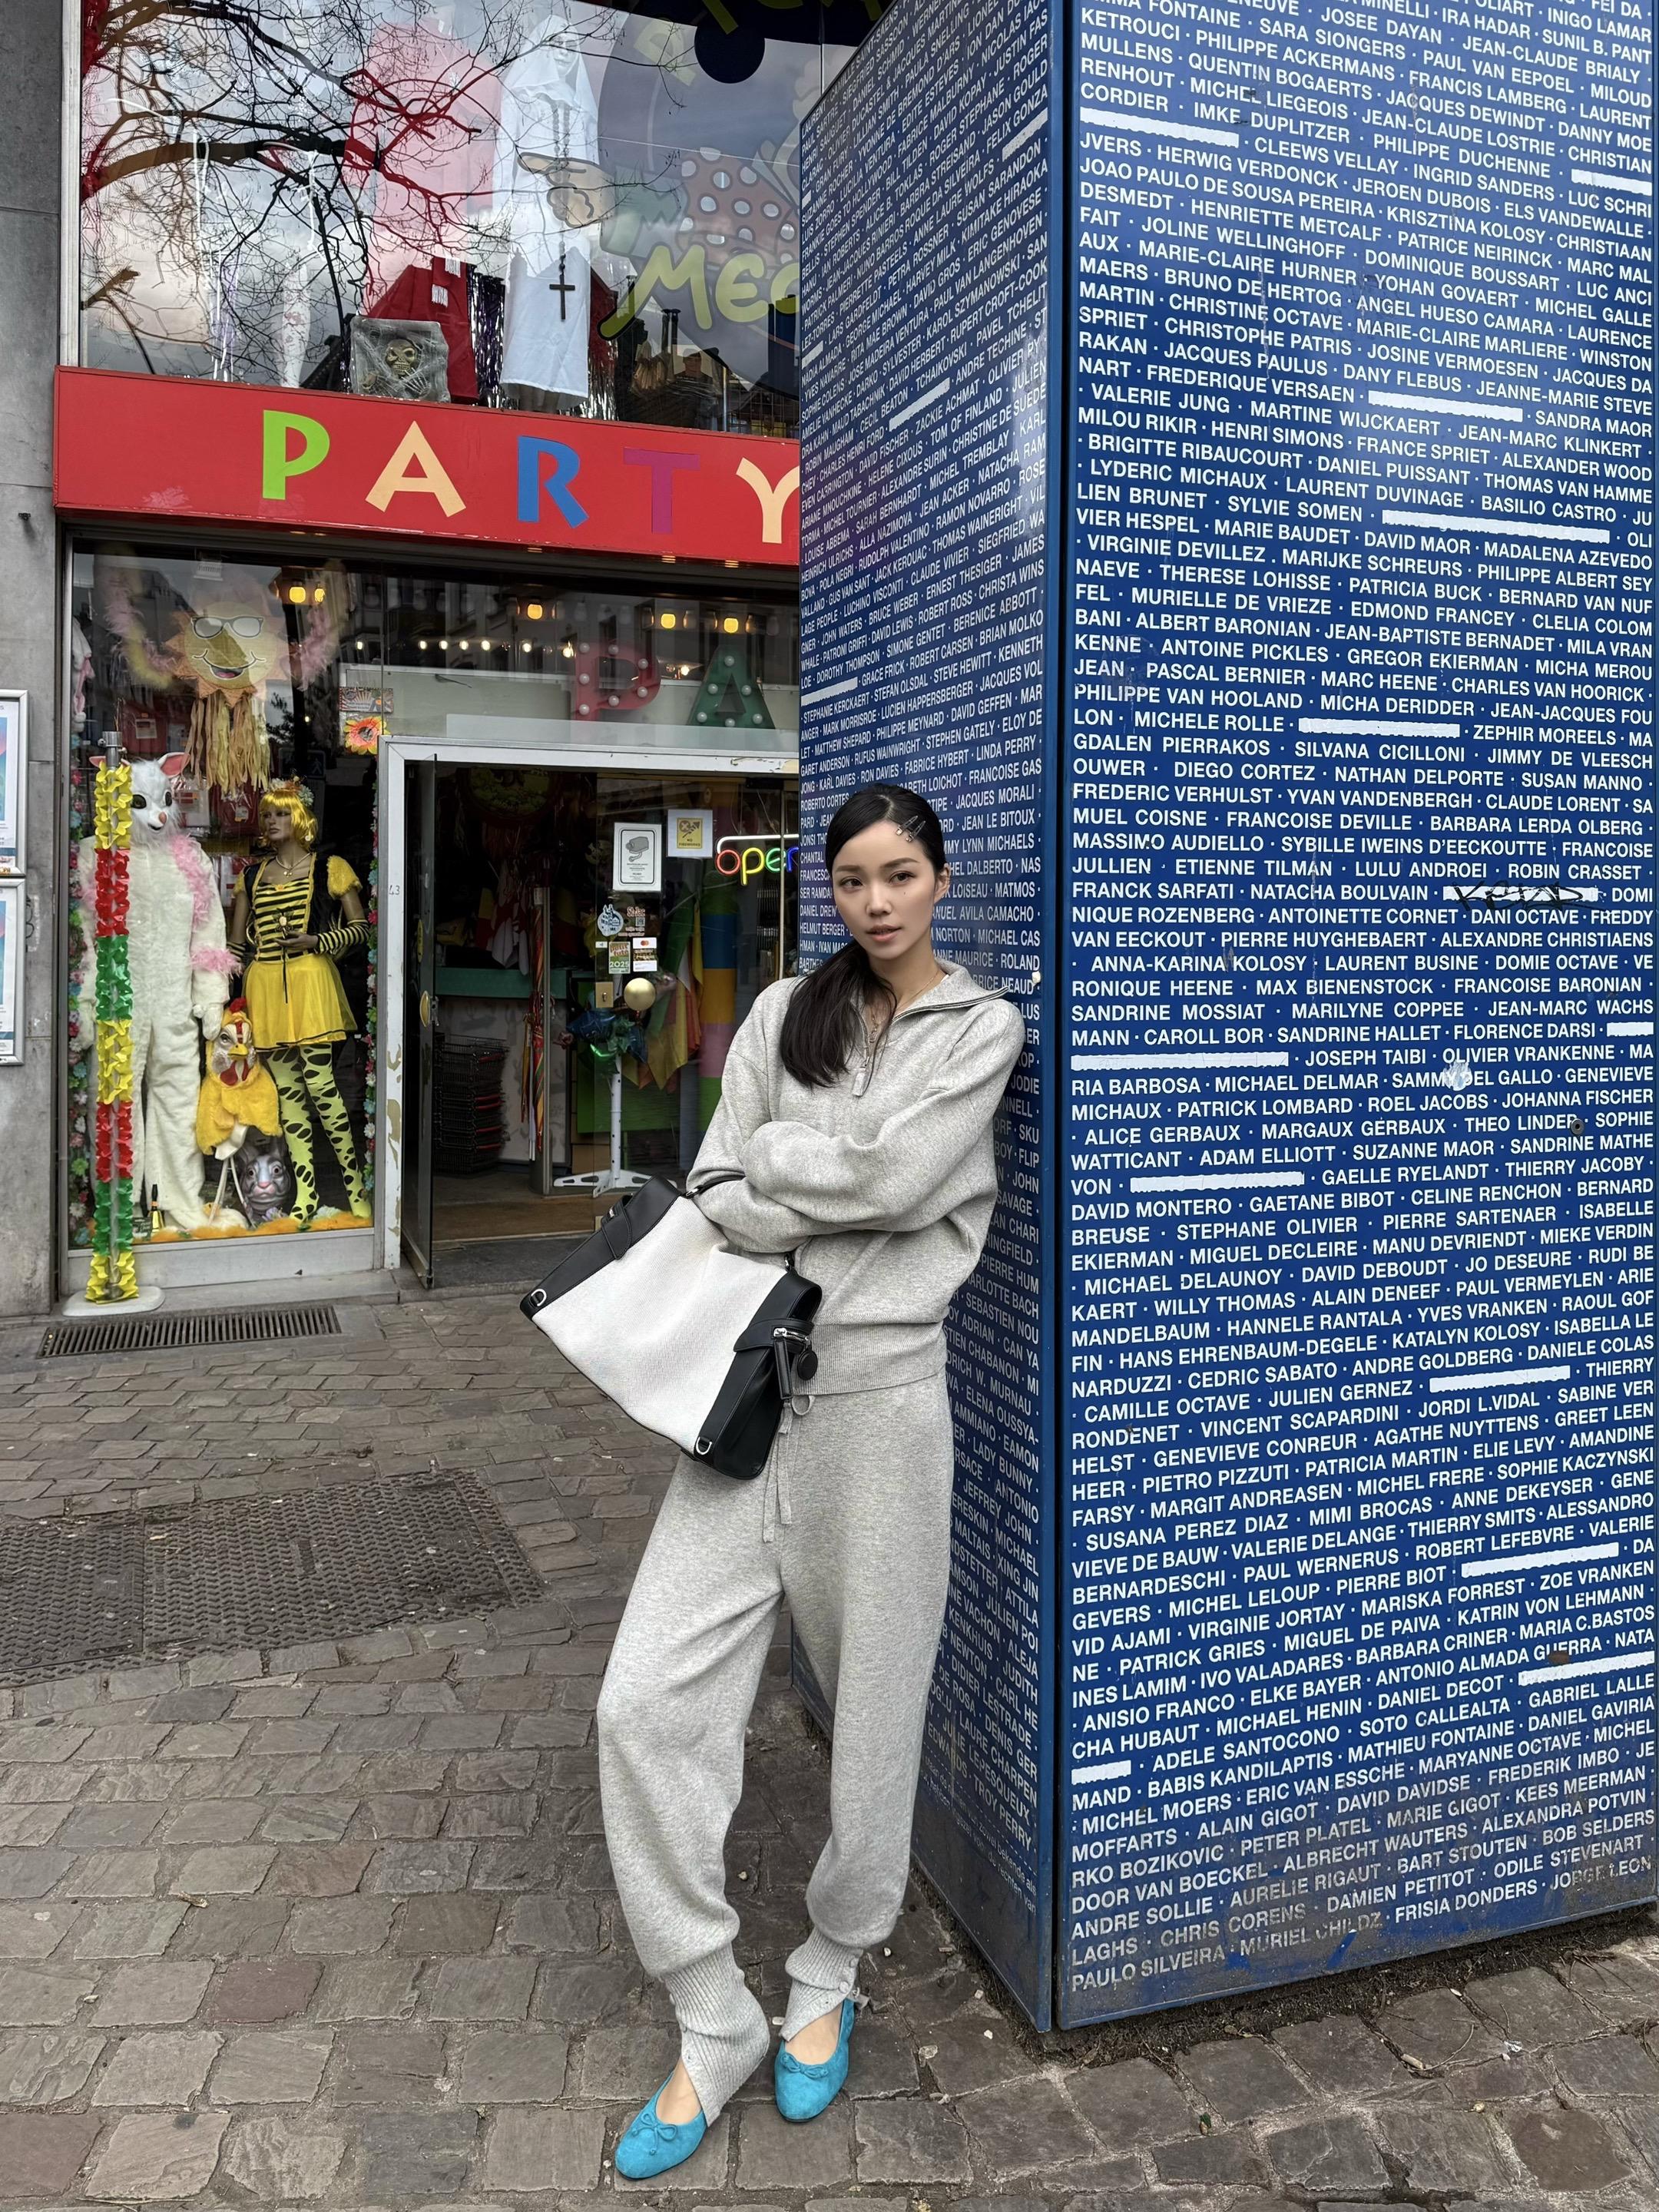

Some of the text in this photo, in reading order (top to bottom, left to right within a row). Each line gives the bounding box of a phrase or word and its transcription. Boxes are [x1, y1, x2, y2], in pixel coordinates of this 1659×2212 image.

[1081, 7, 1651, 130] KETROUCI PHILIPPE ACKERMANS FRANCIS LAMBERG LAURENT
[802, 56, 1047, 316] WORMS JEAN-JACQUES RINIERI BARBRA STREISAND JASON GOULD
[1080, 132, 1643, 238] JVERS HERWIG VERDONCK JEROEN DUBOIS ELS VANDEWALLE
[1079, 231, 1651, 327] AUX MARIE-CLAIRE HURNER YOHAN GOVAERT MICHEL GALLE
[1091, 382, 1641, 458] VALERIE JUNG MARTINE WIJCKAERT JEAN-MARC KLINKERT
[263, 409, 800, 545] PARTY
[801, 507, 1045, 637] LAGE PEOPLE LUCHINO VISCONTI CLAUDE VIVIER SIEGFRIED WA
[1076, 508, 1651, 569] VIER HESPEL MARIE BAUDET DAVID MAOR MADALENA AZEVEDO
[1075, 634, 1651, 680] KENNE ANTOINE PICKLES GREGOR EKIERMAN MICHA MEROU
[800, 657, 1042, 743] ANGER MARK MORRISROE LUCIEN HAPPERSBERGER JACQUES VOL
[1072, 783, 1653, 813] FREDERIC VERHULST YVAN VANDENBERGH CLAUDE LORENT SA
[1072, 906, 1653, 924] NIQUE ROZENBERG ANTOINETTE CORNET DANI OCTAVE FREDDY
[1071, 998, 1653, 1021] SANDRINE MOSSIAT MARILYNE COPPEE JEAN-MARC WACHS
[1071, 1088, 1653, 1120] MICHAUX PATRICK LOMBARD ROEL JACOBS JOHANNA FISCHER
[1071, 1200, 1653, 1245] BREUSE STEPHANE OLIVIER PIERRE SARTENAER ISABELLE
[965, 1293, 1038, 1345] SEBASTIEN NOU
[1072, 1290, 1654, 1346] MANDELBAUM HANNELE RANTALA YVES VRANKEN RAOUL GOF
[973, 1441, 1032, 1488] LADY BUNNY
[1072, 1424, 1654, 1501] HEER PIETRO PIZZUTI PATRICIA MARTIN ELIE LEVY AMANDINE
[1073, 1514, 1654, 1604] BERNARDESCHI PAUL WERNERUS ROBERT LEFEBVRE VALERIE
[1072, 1674, 1504, 1759] CHA HUBAUT MICHAEL HENIN DANIEL DECOT
[974, 1774, 997, 1813] TROY
[1000, 1804, 1031, 1851] PERRY
[1072, 1740, 1654, 1862] MOFFARTS ALAIN GIGOT DAVID DAVIDSE FREDERIK IMBO JE
